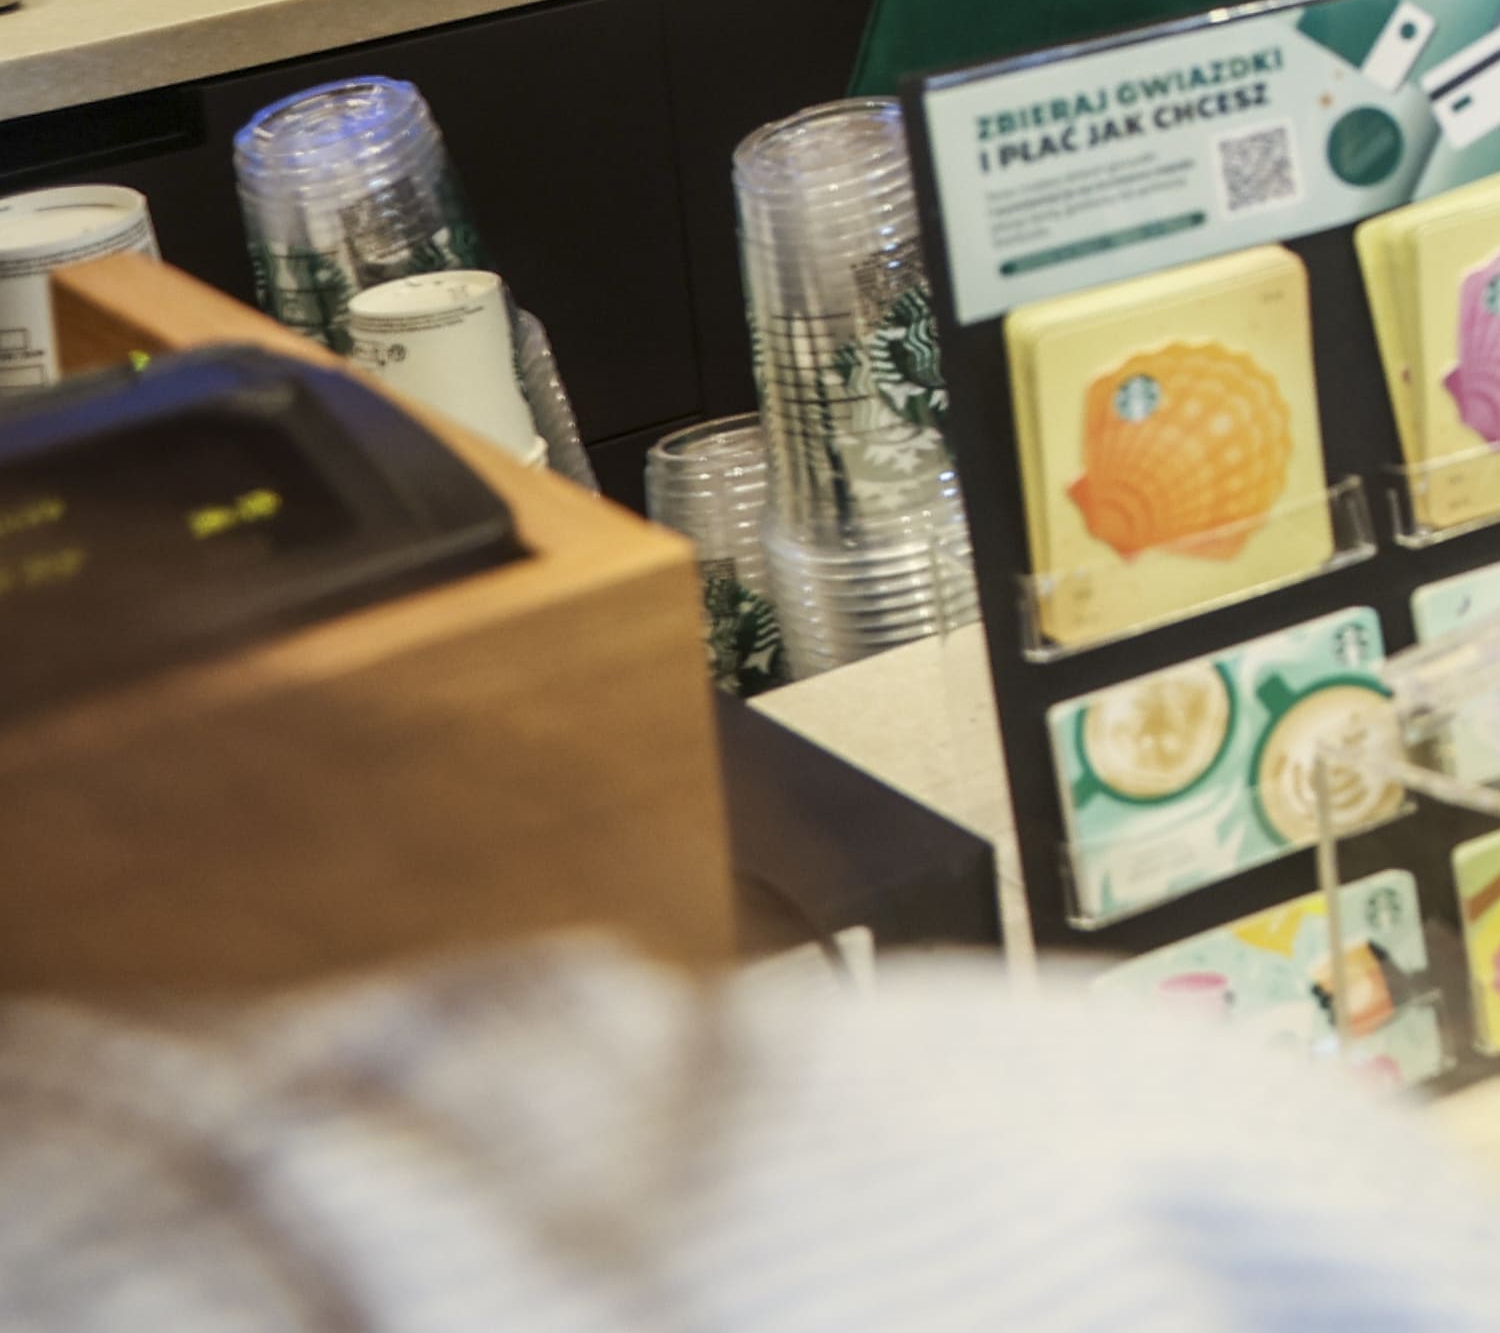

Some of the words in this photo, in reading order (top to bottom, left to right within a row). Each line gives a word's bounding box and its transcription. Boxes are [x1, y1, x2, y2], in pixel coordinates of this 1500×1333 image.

[975, 86, 1108, 141] ZBIERAJ
[1115, 46, 1284, 106] GWIAZDKI
[1087, 111, 1145, 147] JAK
[1152, 83, 1270, 130] CHCESZ
